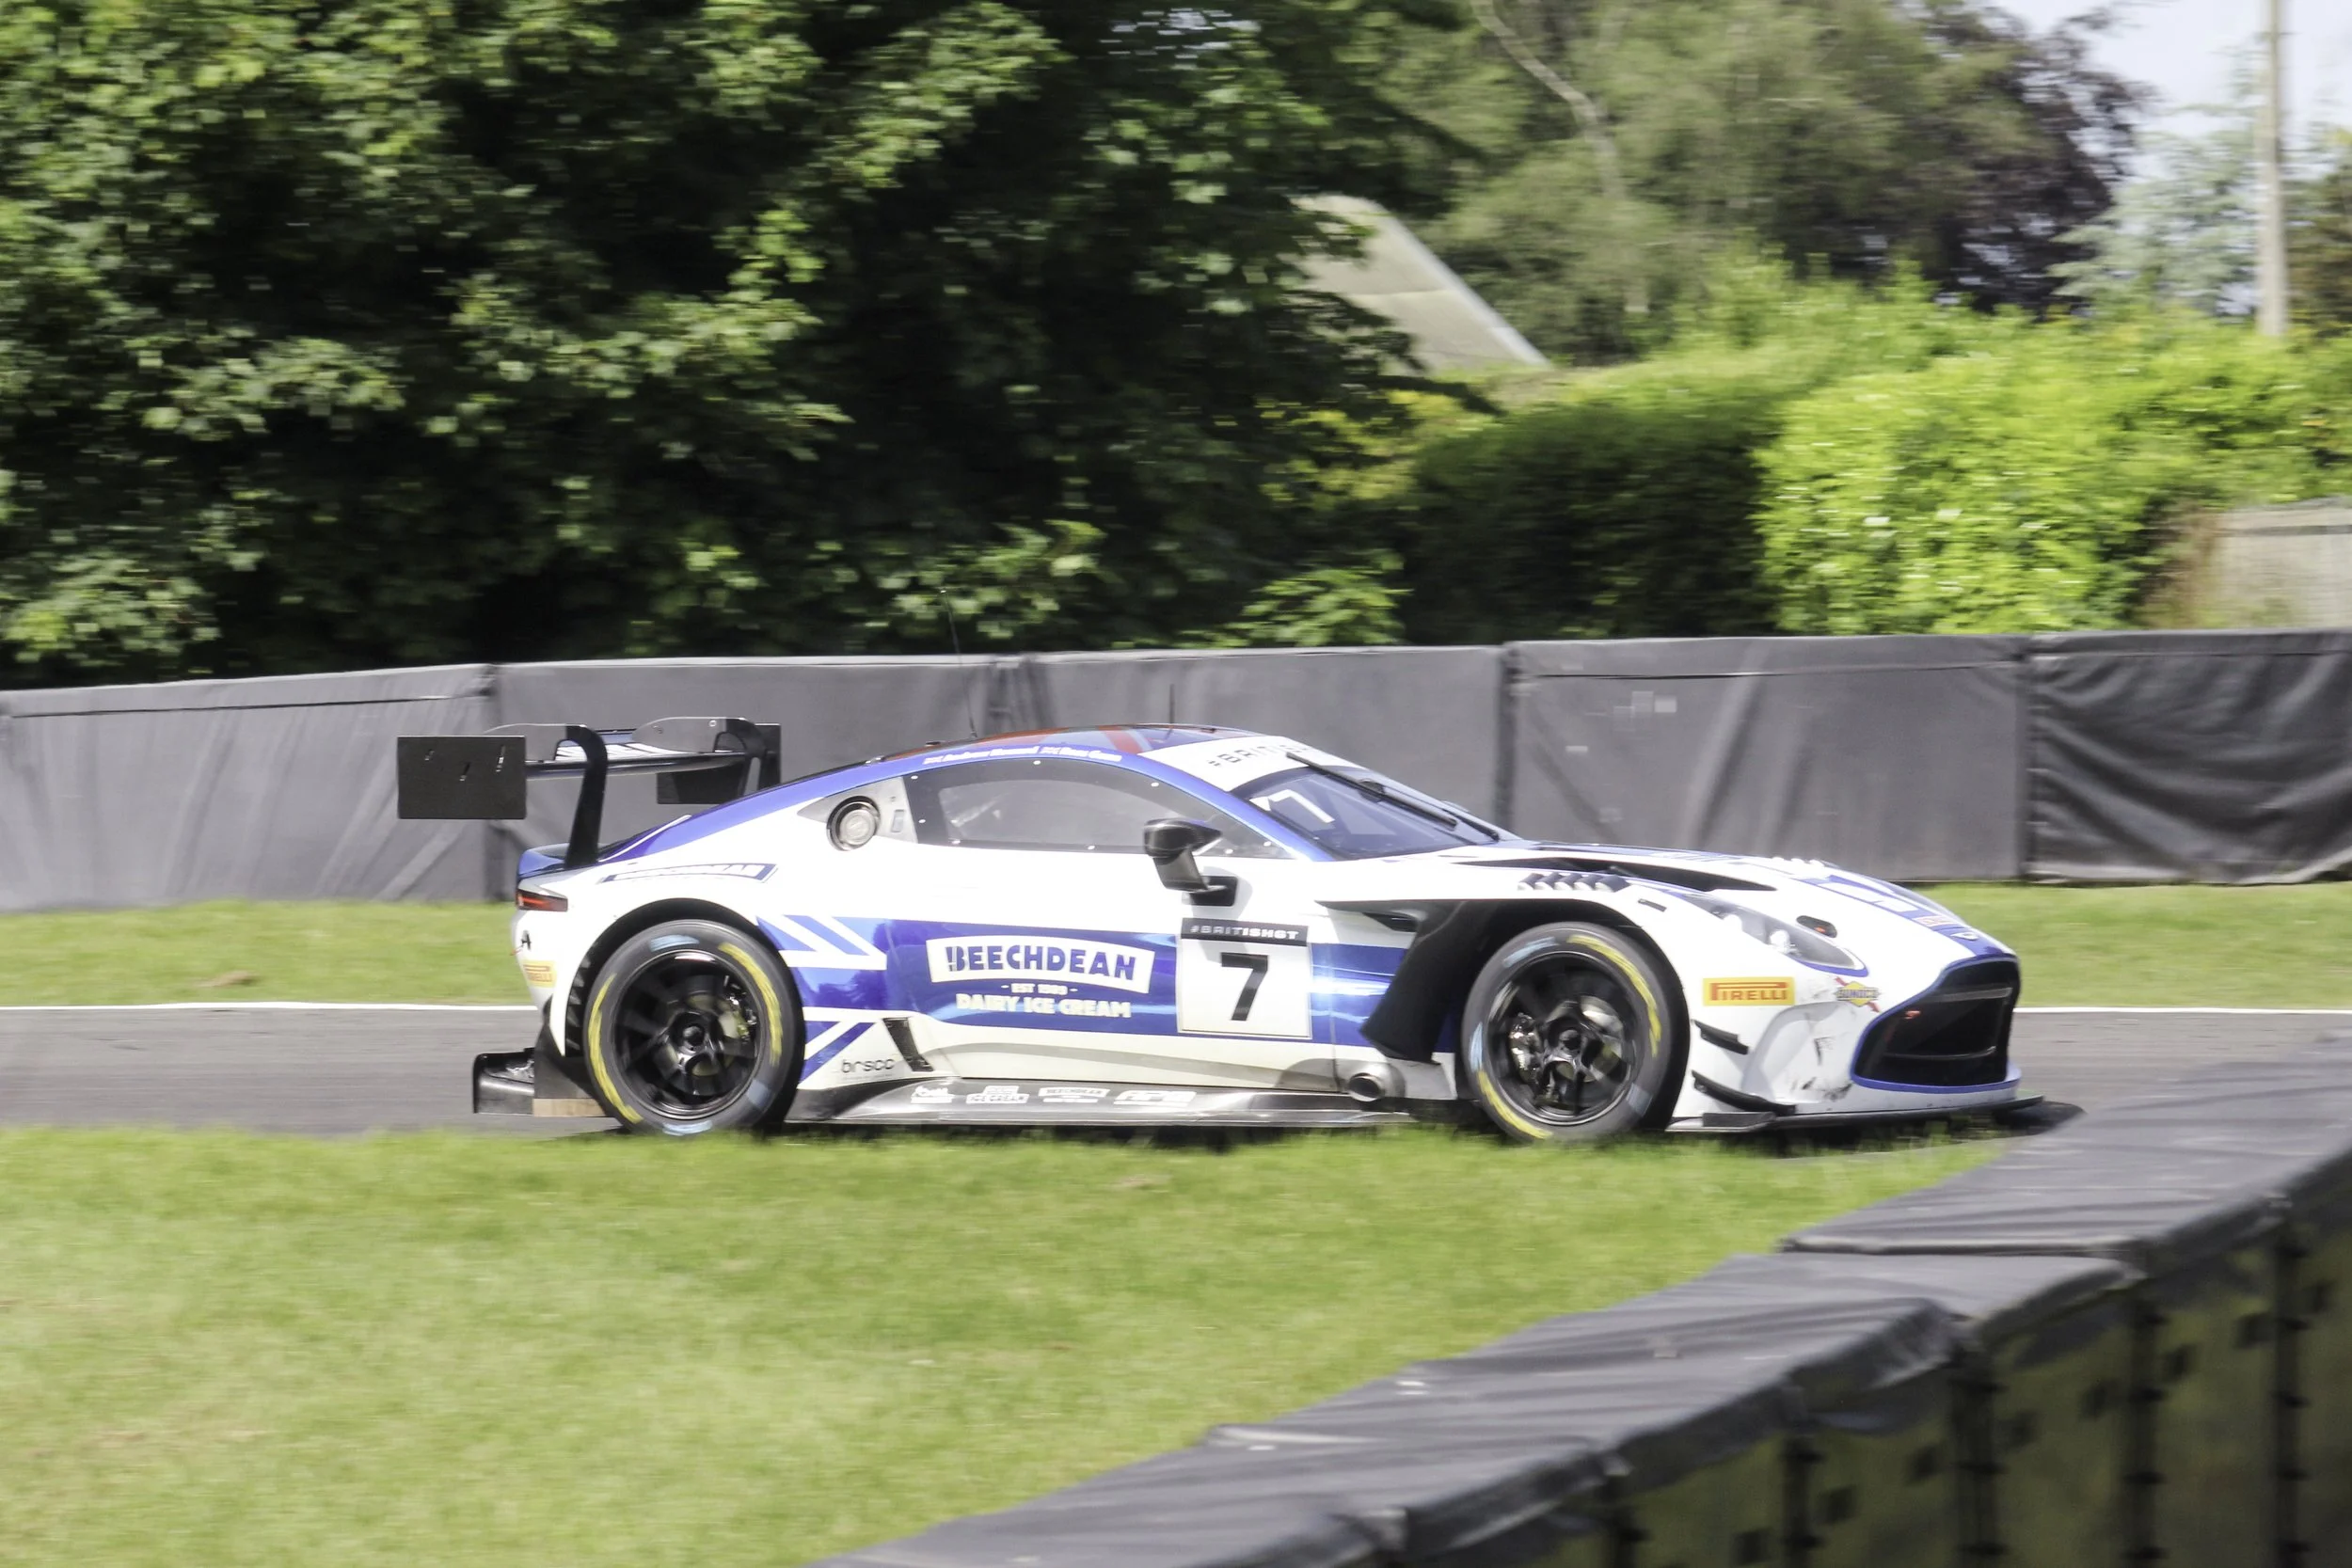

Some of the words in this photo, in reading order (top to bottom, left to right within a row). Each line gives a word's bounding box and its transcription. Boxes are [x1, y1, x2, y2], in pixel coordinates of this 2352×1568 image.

[946, 944, 1136, 980] BEECHDEAN
[1220, 951, 1268, 1022] 7
[1709, 981, 1788, 1001] PIRELLI
[956, 993, 1020, 1012] DAIRY
[1024, 997, 1055, 1014] ICE
[1057, 999, 1131, 1018] CREAM
